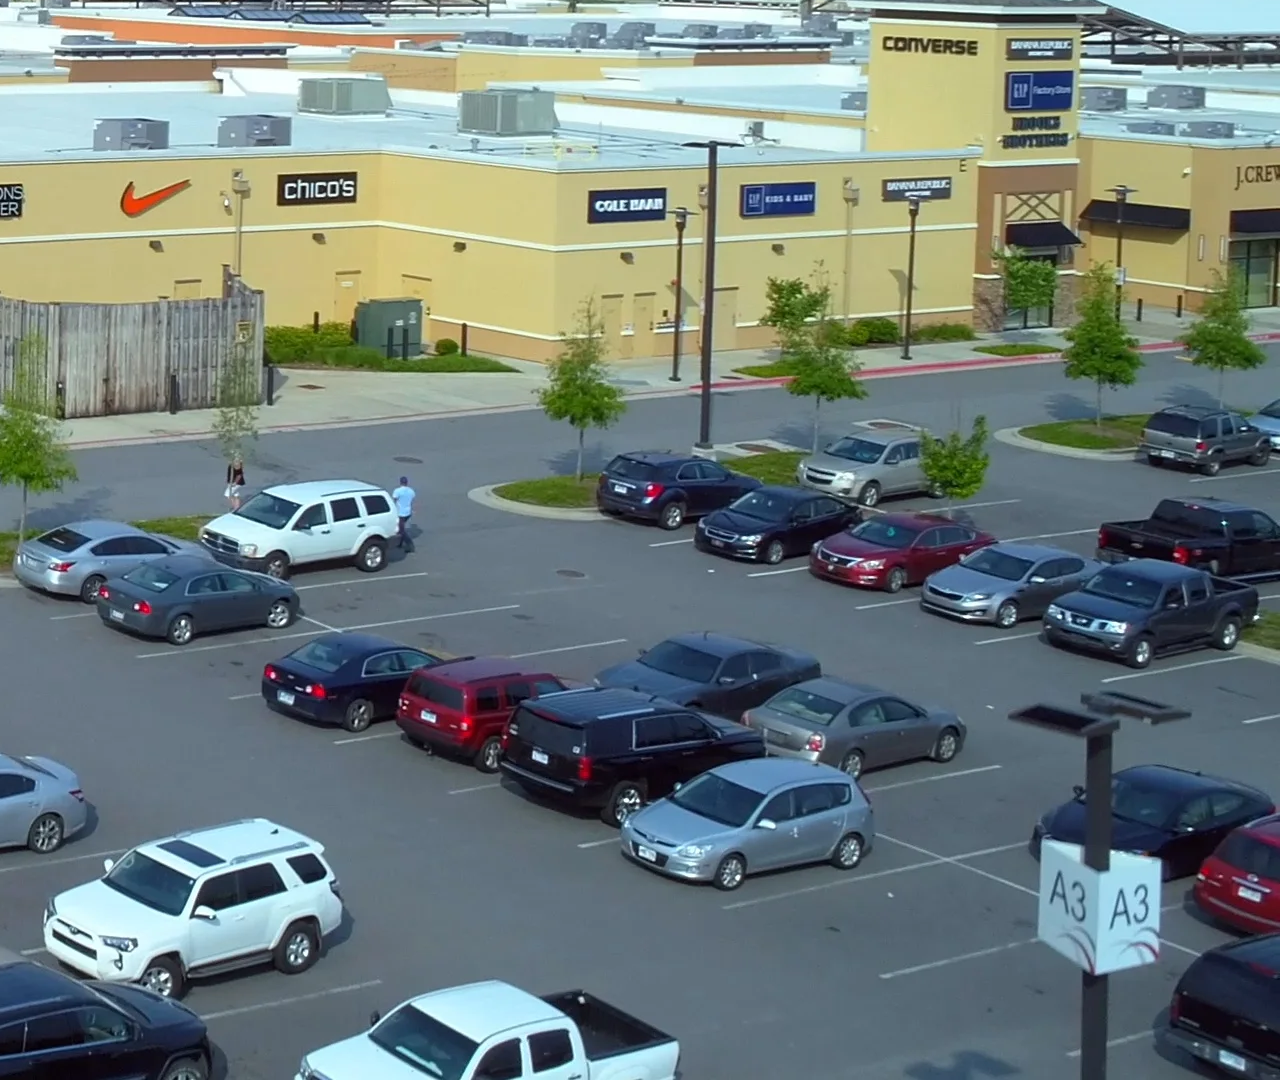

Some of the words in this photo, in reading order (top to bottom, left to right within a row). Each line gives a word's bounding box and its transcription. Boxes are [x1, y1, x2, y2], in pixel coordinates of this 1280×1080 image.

[882, 36, 978, 56] CONVERSE
[1013, 83, 1028, 98] GAP
[959, 159, 967, 172] E
[595, 199, 628, 212] COLE
[765, 195, 784, 203] KIDS
[1049, 869, 1086, 922] A3
[1109, 883, 1149, 930] A3
